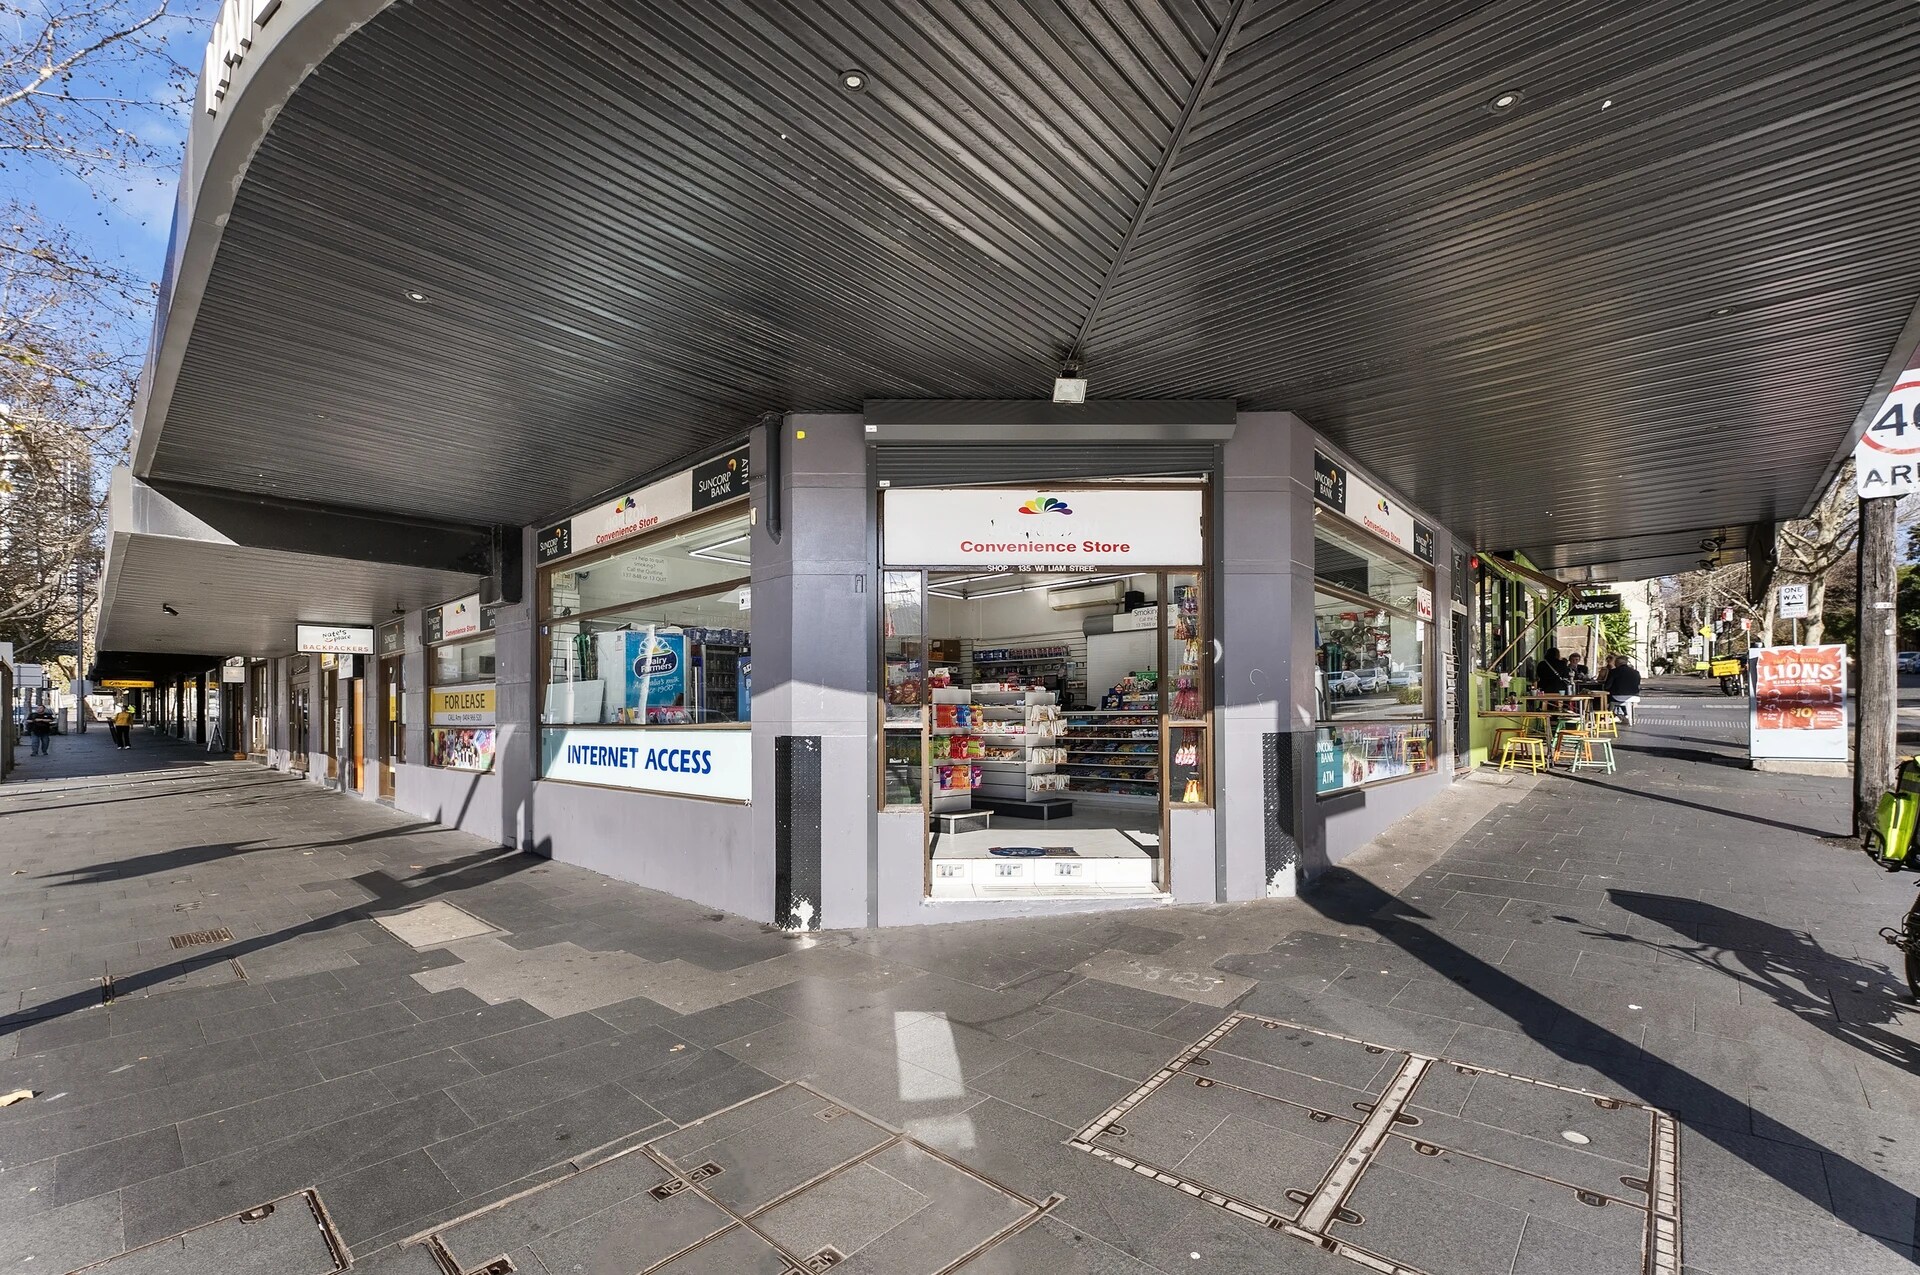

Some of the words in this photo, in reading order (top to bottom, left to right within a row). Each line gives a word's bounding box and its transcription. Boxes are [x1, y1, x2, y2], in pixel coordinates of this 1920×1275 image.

[1872, 402, 1920, 437] 4
[741, 458, 749, 485] ATM
[1863, 462, 1920, 488] AR
[698, 471, 732, 493] SUNCORP
[1314, 470, 1333, 489] UNCORP
[711, 482, 731, 498] BANK
[1320, 484, 1333, 499] BANK
[596, 523, 638, 544] Convenience
[638, 516, 659, 528] Store
[540, 537, 559, 552] SUNCORP
[546, 547, 559, 557] BANK
[960, 540, 1077, 553] Convenience
[1082, 540, 1131, 553] Store
[487, 609, 496, 617] BAN
[1134, 607, 1158, 617] Smokin
[322, 629, 347, 638] Nate's
[445, 626, 467, 637] Convenience
[466, 624, 477, 634] Store
[303, 644, 369, 652] BACKPACKERS
[646, 657, 667, 666] Dairy
[1763, 663, 1838, 681] LIONS
[445, 695, 459, 709] FOR
[461, 693, 485, 709] LEASE
[1790, 706, 1813, 718] $10
[567, 745, 639, 768] INTERNET
[645, 748, 712, 775] ACCESS
[1321, 752, 1334, 763] BANK
[1322, 770, 1335, 784] ATM
